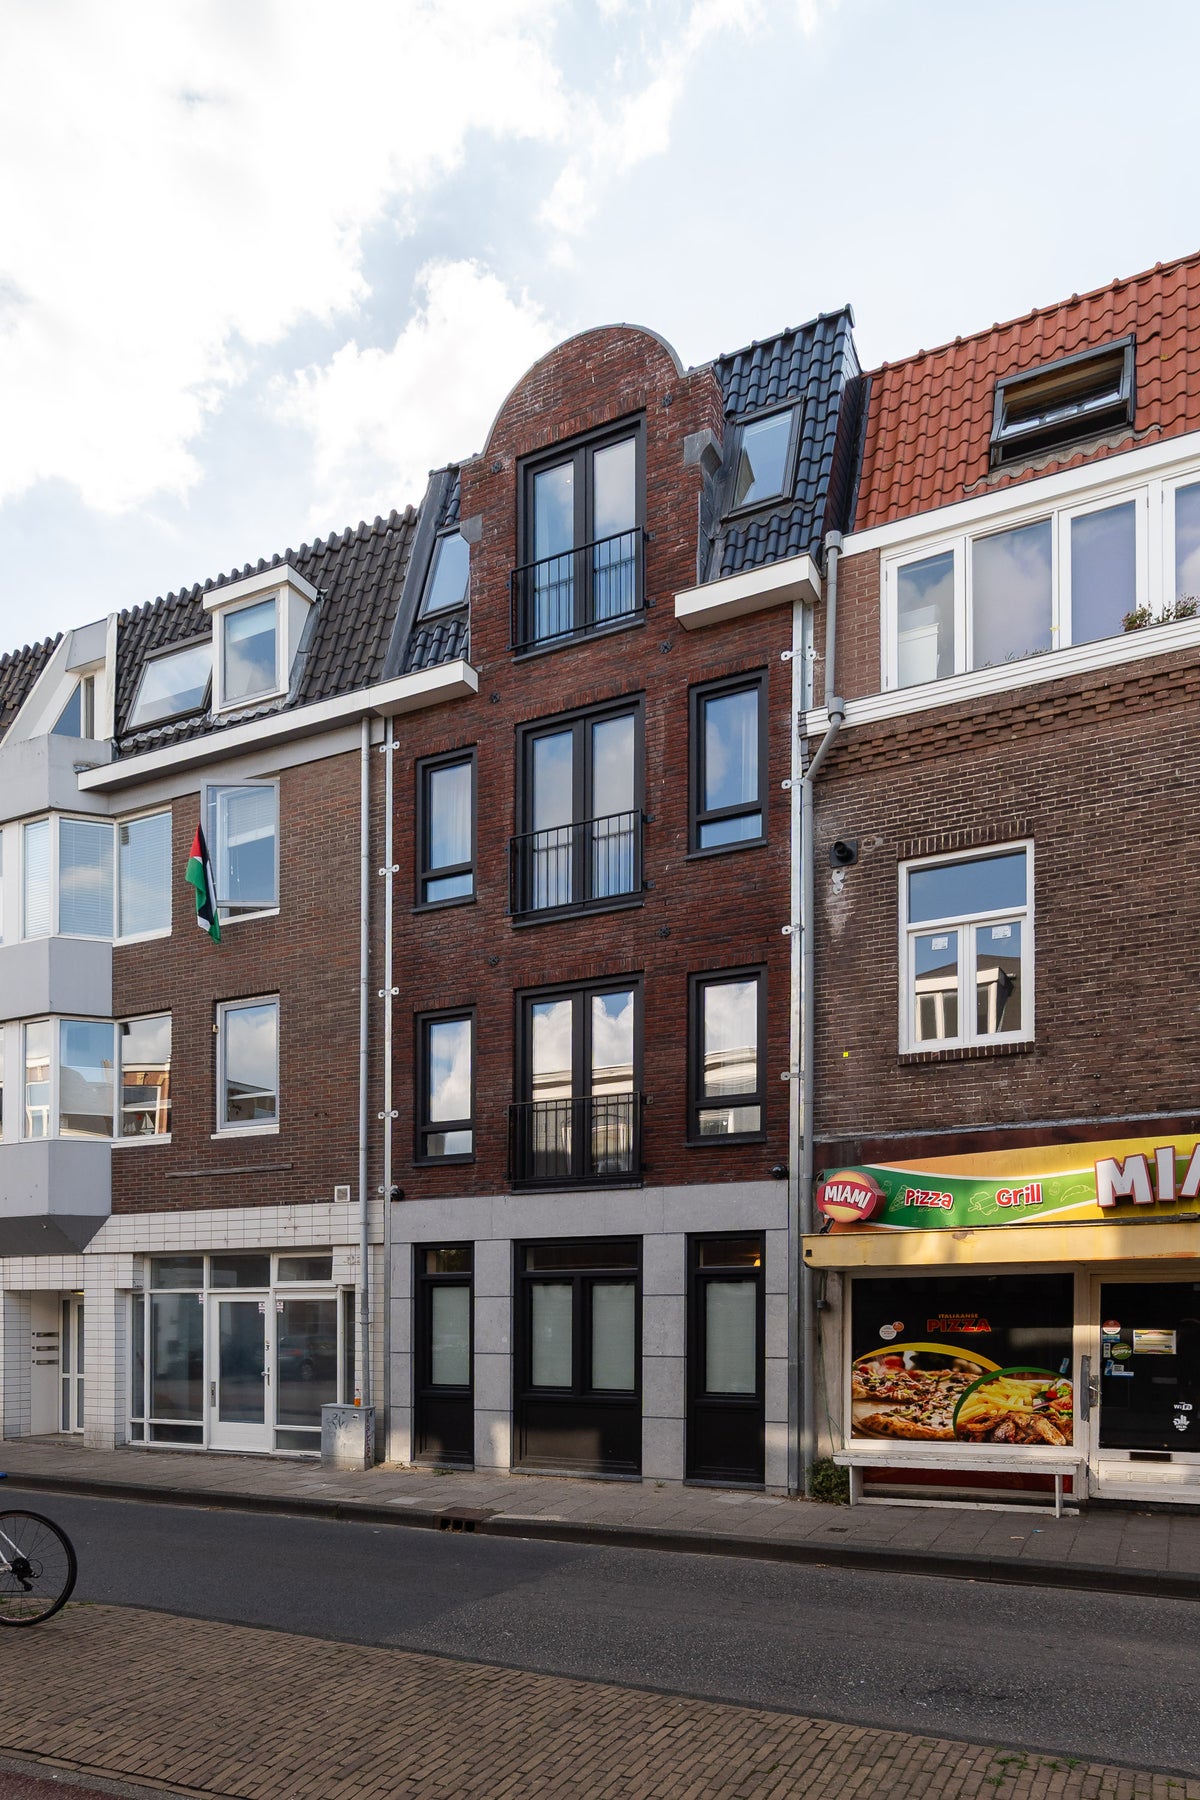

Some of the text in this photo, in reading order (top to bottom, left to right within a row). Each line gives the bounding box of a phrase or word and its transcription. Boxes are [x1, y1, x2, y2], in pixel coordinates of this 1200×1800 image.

[824, 1185, 872, 1209] MIAMI
[905, 1188, 953, 1210] Pizza
[995, 1183, 1043, 1207] Grill
[927, 1318, 992, 1333] PIZZA
